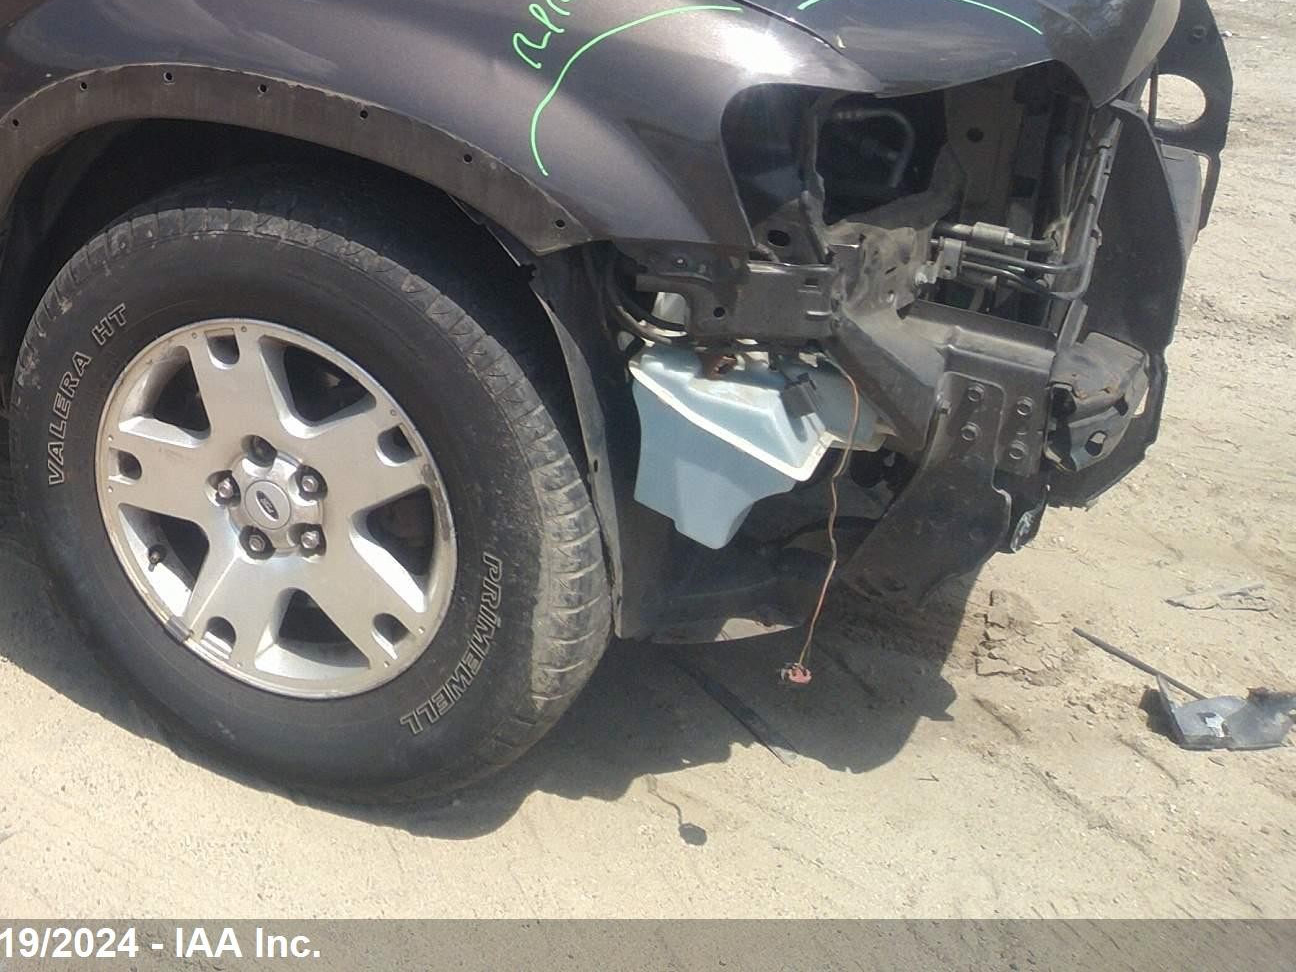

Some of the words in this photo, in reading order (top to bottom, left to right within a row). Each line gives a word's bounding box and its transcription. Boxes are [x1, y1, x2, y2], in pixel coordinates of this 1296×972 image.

[47, 351, 93, 484] VALERA
[91, 302, 127, 346] HT
[399, 551, 503, 735] PRIMEWELL
